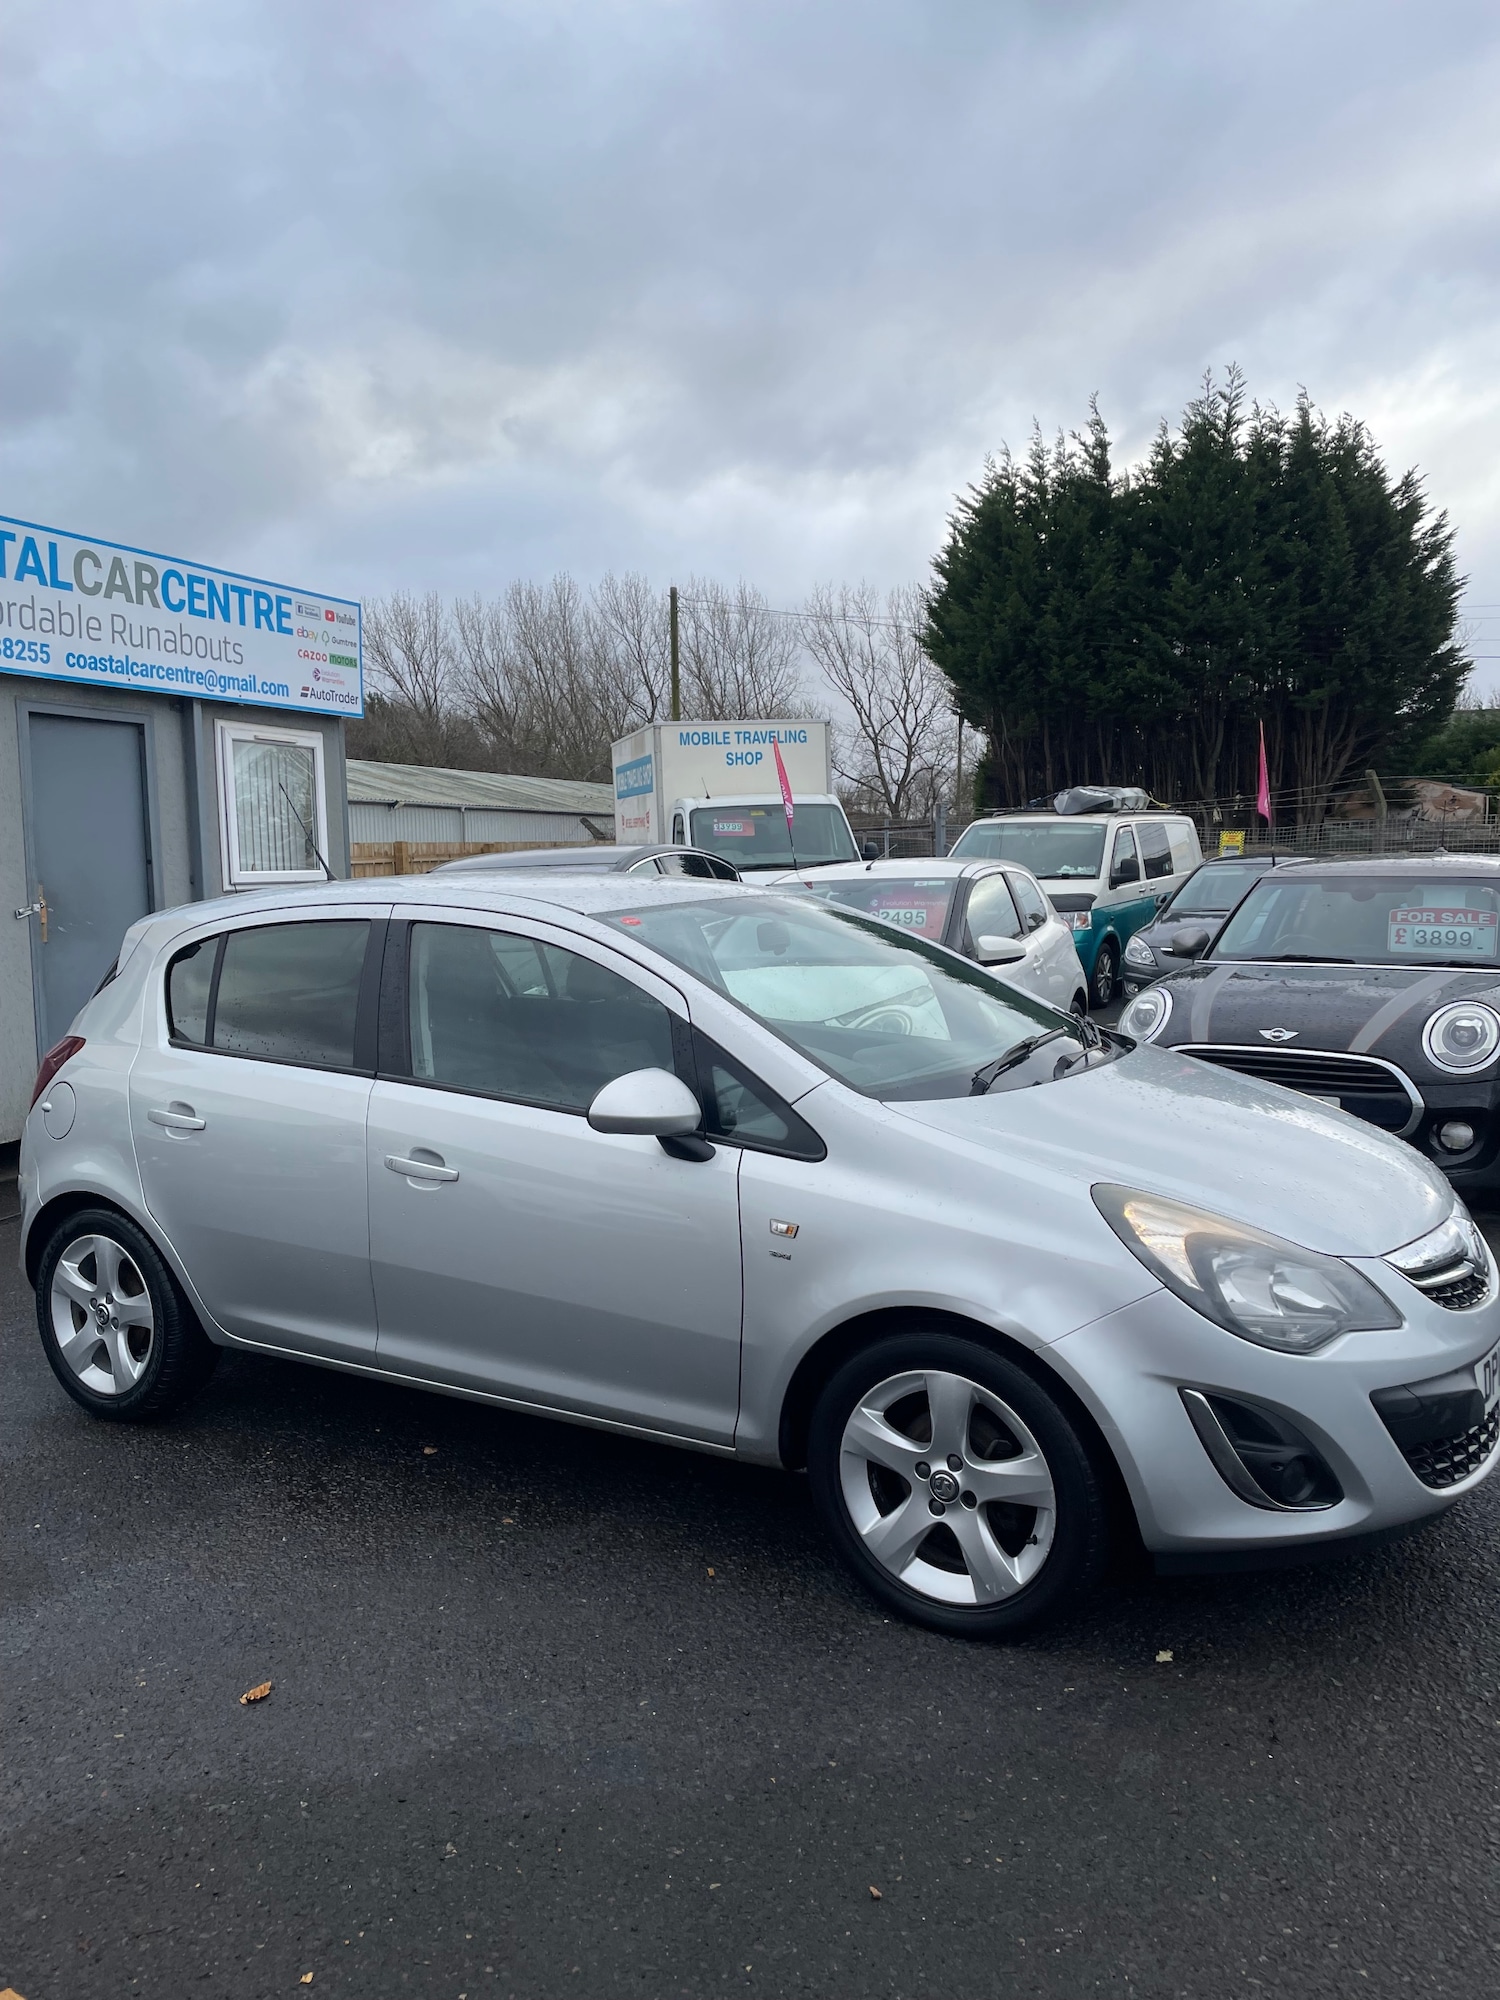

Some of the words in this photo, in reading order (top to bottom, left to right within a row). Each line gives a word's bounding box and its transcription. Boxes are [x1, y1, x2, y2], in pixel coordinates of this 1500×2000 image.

[0, 595, 102, 642] rdable
[110, 613, 244, 665] Runabouts
[331, 637, 357, 648] Gumtree
[0, 637, 51, 665] 8255
[65, 652, 290, 698] coastalcarcentre@gmail.com
[309, 686, 359, 705] AutoTrader
[679, 731, 731, 746] MOBILE
[734, 730, 807, 745] TRAVELING
[726, 751, 763, 766] SHOP
[1396, 911, 1436, 923] FOR
[1441, 911, 1491, 924] SALE
